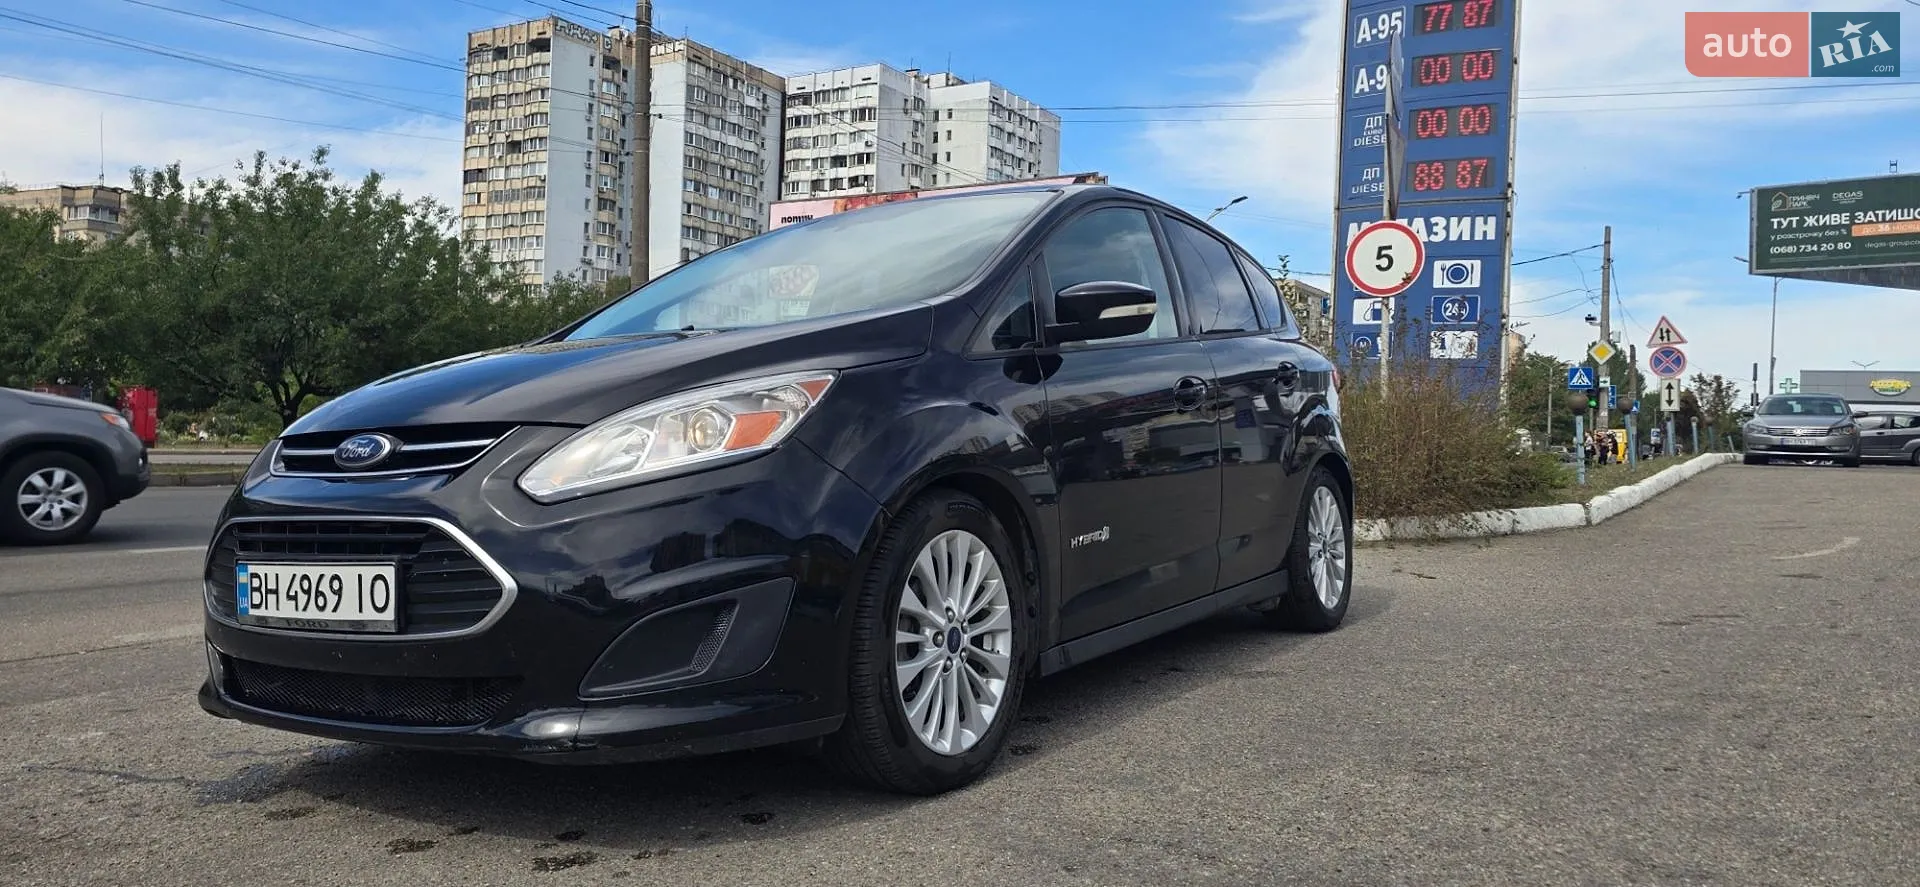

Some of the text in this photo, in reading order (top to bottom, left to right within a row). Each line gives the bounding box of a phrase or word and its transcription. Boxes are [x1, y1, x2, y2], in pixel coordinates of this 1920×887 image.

[1423, 0, 1493, 31] 77 87
[1420, 53, 1494, 85] 00 00
[1355, 65, 1388, 95] А-9
[1364, 116, 1382, 130] ДП
[1417, 106, 1490, 138] 00 00
[1353, 134, 1387, 147] DIESE
[1362, 167, 1380, 181] ДП
[1414, 159, 1488, 192] 88 87
[1351, 182, 1385, 194] DIESE
[1832, 191, 1864, 199] DEGAS
[1770, 217, 1800, 229] ТУТ
[1803, 213, 1850, 227] ЖИВЕ
[1770, 242, 1852, 254] (068) 734 20 80
[1375, 245, 1394, 272] 5
[342, 439, 375, 459] Ford
[250, 572, 280, 612] BH
[286, 573, 344, 613] 4969
[239, 595, 249, 609] UA
